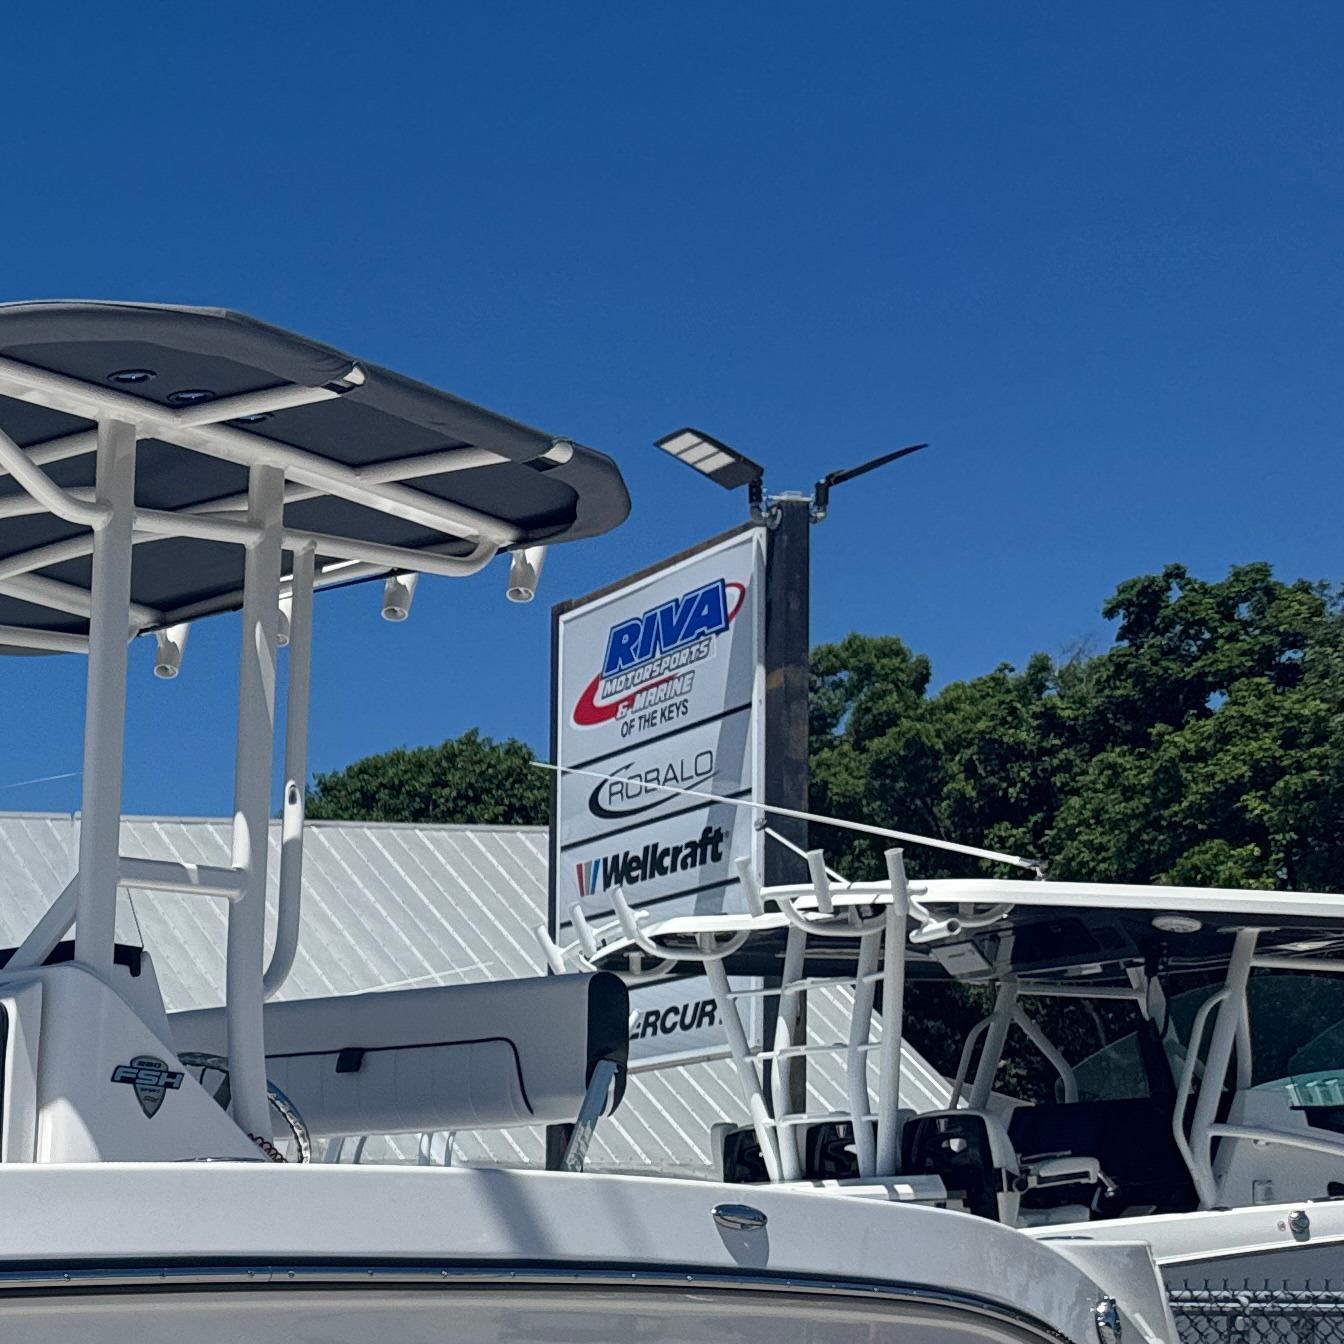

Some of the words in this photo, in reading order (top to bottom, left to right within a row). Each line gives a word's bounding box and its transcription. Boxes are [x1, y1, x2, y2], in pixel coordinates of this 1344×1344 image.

[602, 578, 729, 678] RIVA
[602, 638, 712, 699] MOTORSPORTS
[632, 670, 695, 713] MARINE
[621, 719, 635, 738] OF
[638, 709, 657, 732] THE
[660, 699, 688, 724] KEYS
[609, 750, 713, 805] ROBALO
[602, 826, 724, 892] Wellcraft
[112, 1066, 183, 1089] FSH
